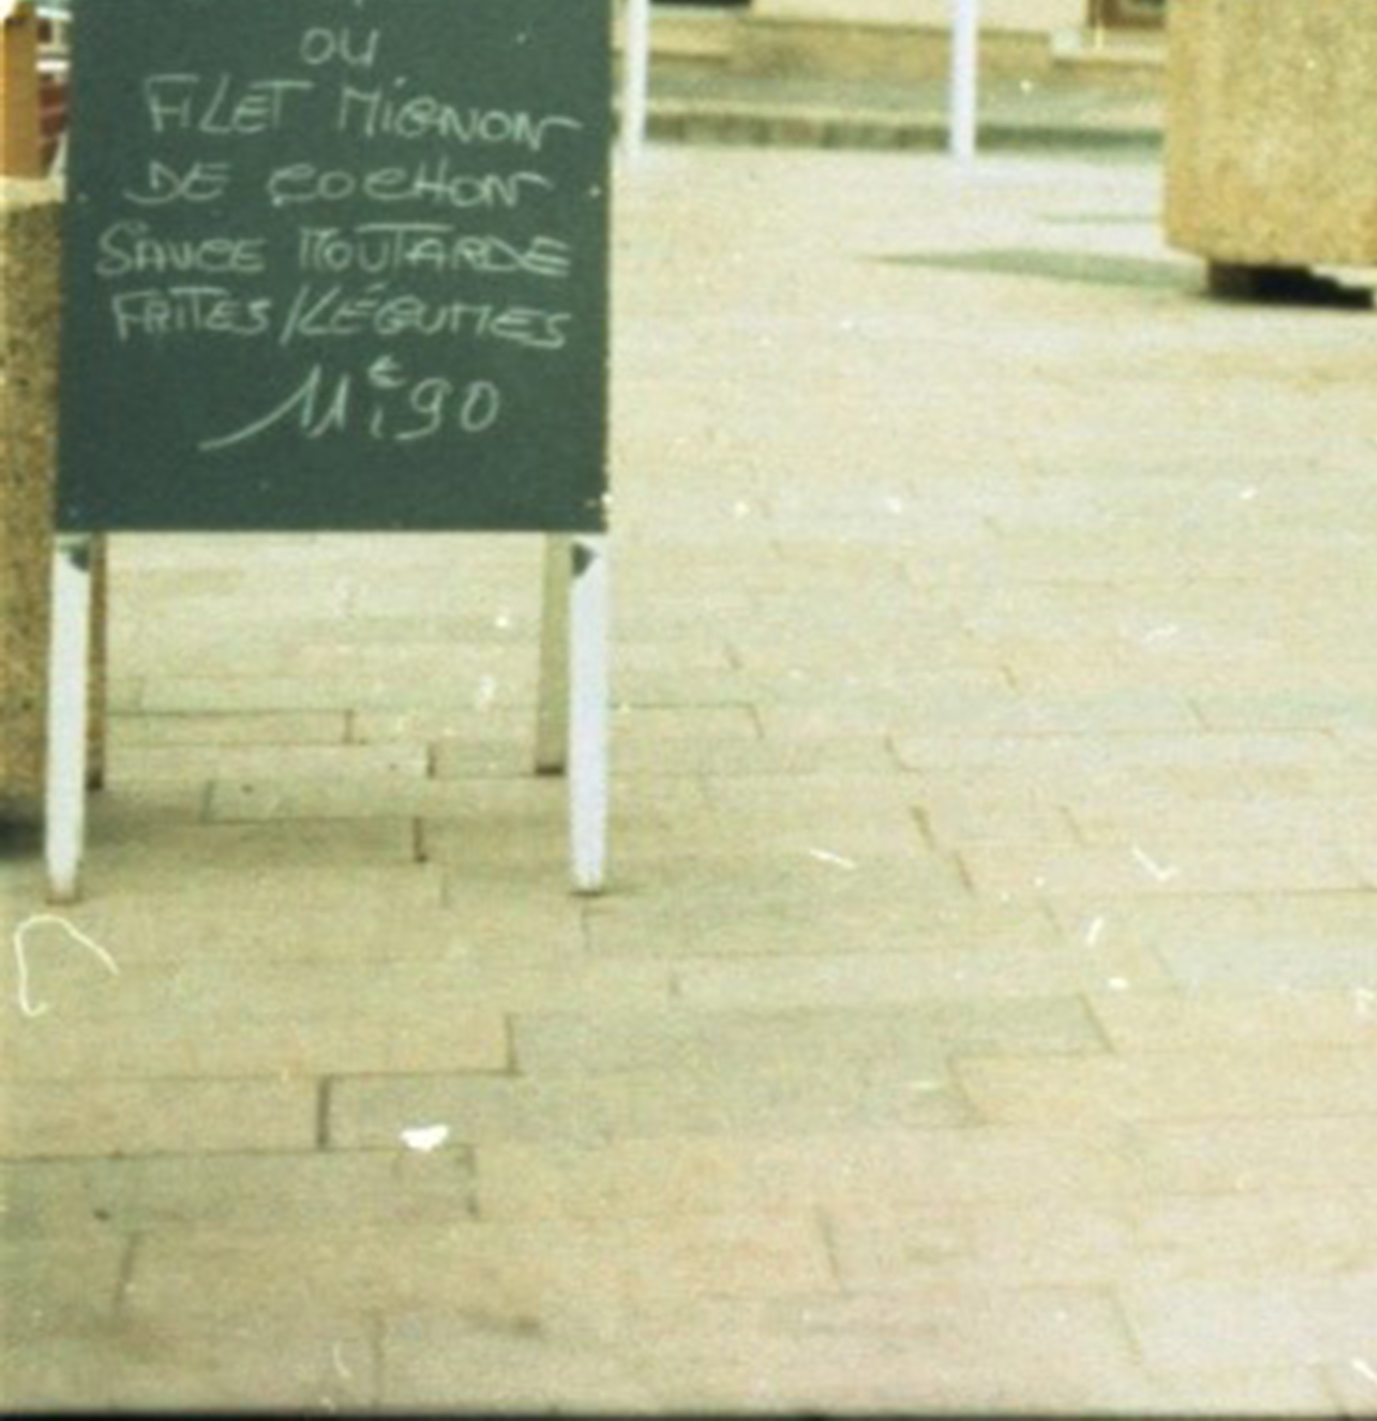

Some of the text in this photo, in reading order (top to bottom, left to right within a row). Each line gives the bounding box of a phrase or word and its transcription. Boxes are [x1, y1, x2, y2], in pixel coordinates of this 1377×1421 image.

[302, 28, 380, 66] OU
[143, 73, 315, 135] FILET
[122, 156, 556, 207] DE COCHON
[95, 221, 572, 277] SAUCE MOUTARDE
